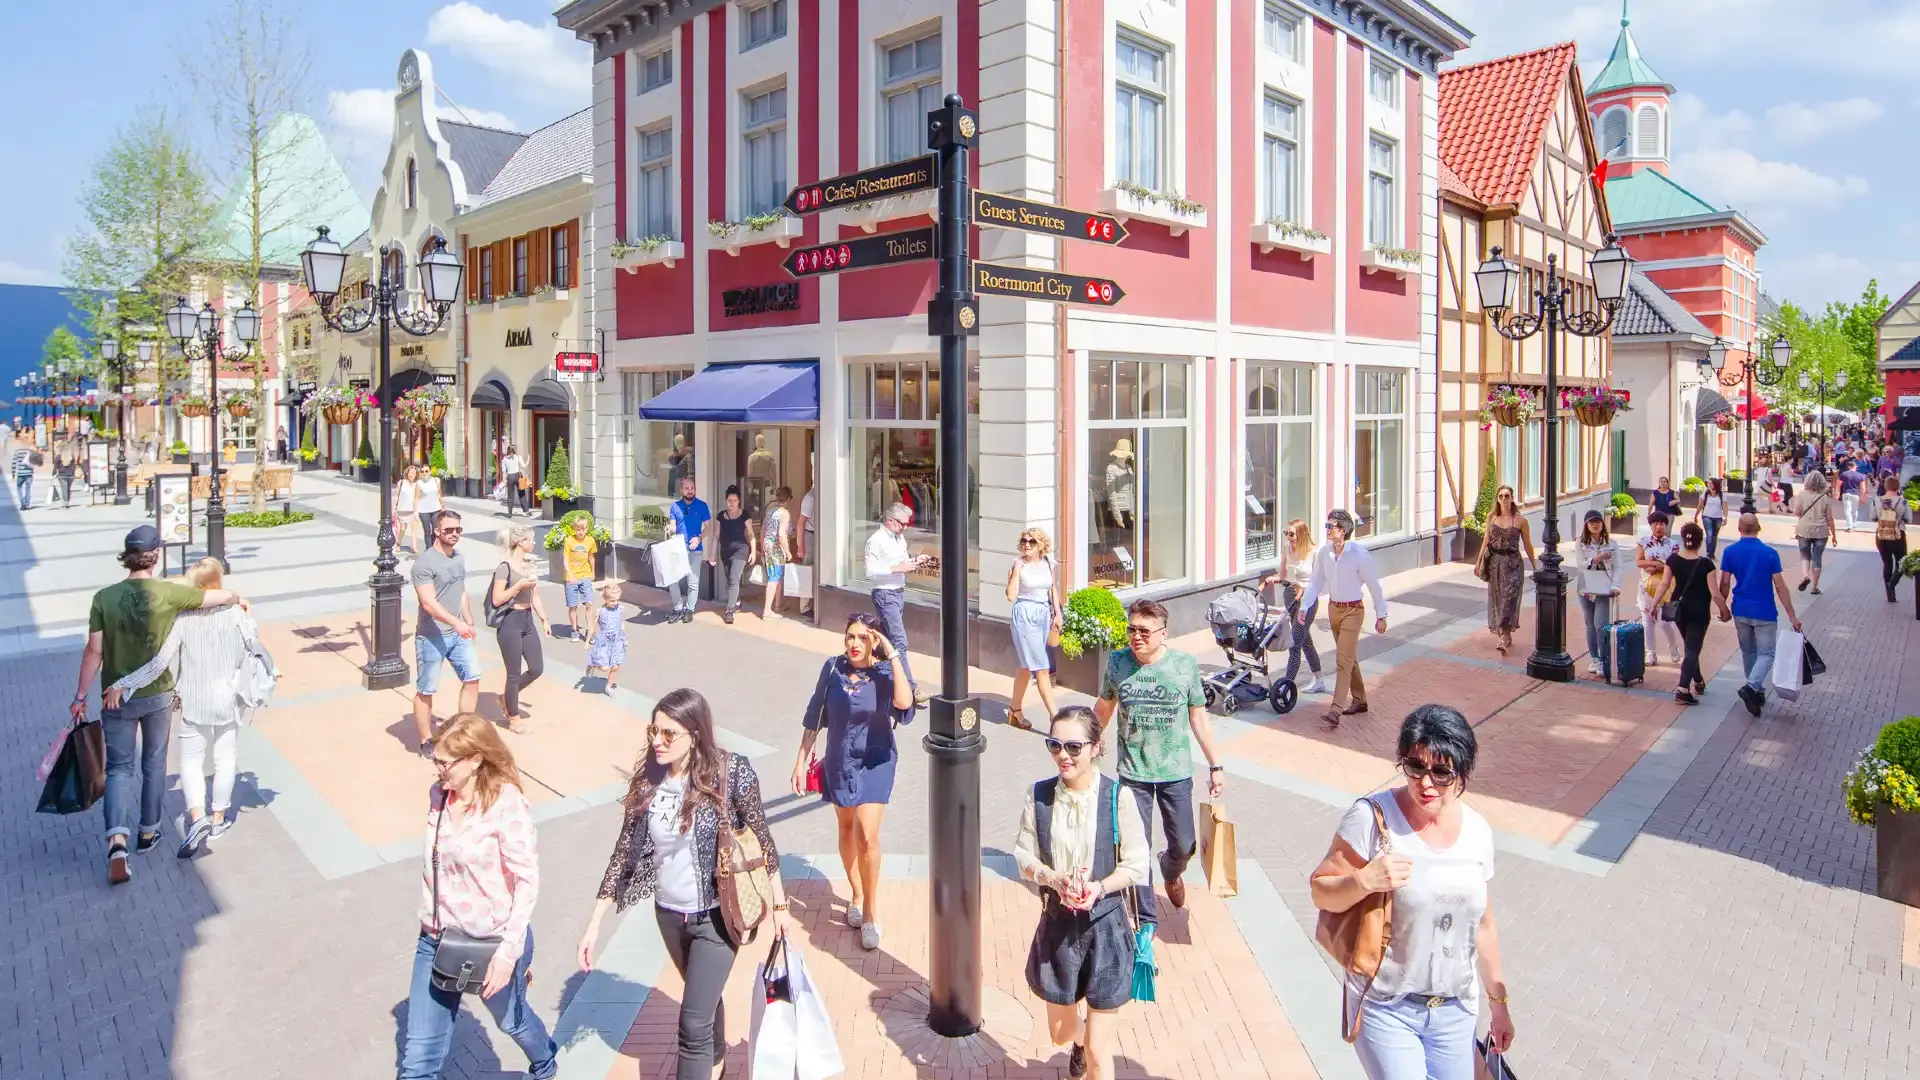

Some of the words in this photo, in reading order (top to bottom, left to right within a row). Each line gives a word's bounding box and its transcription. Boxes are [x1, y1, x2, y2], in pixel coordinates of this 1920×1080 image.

[825, 170, 927, 203] Cafes/Restaurants
[979, 200, 1017, 223] Guest
[1019, 207, 1065, 231] Services
[886, 237, 927, 257] Toilets
[979, 270, 1044, 293] Roermond
[1047, 279, 1072, 300] City
[505, 326, 532, 347] ARMA
[435, 375, 454, 383] ARMA
[1247, 534, 1274, 545] WOOLRICH
[1094, 560, 1132, 574] WOOLRICH
